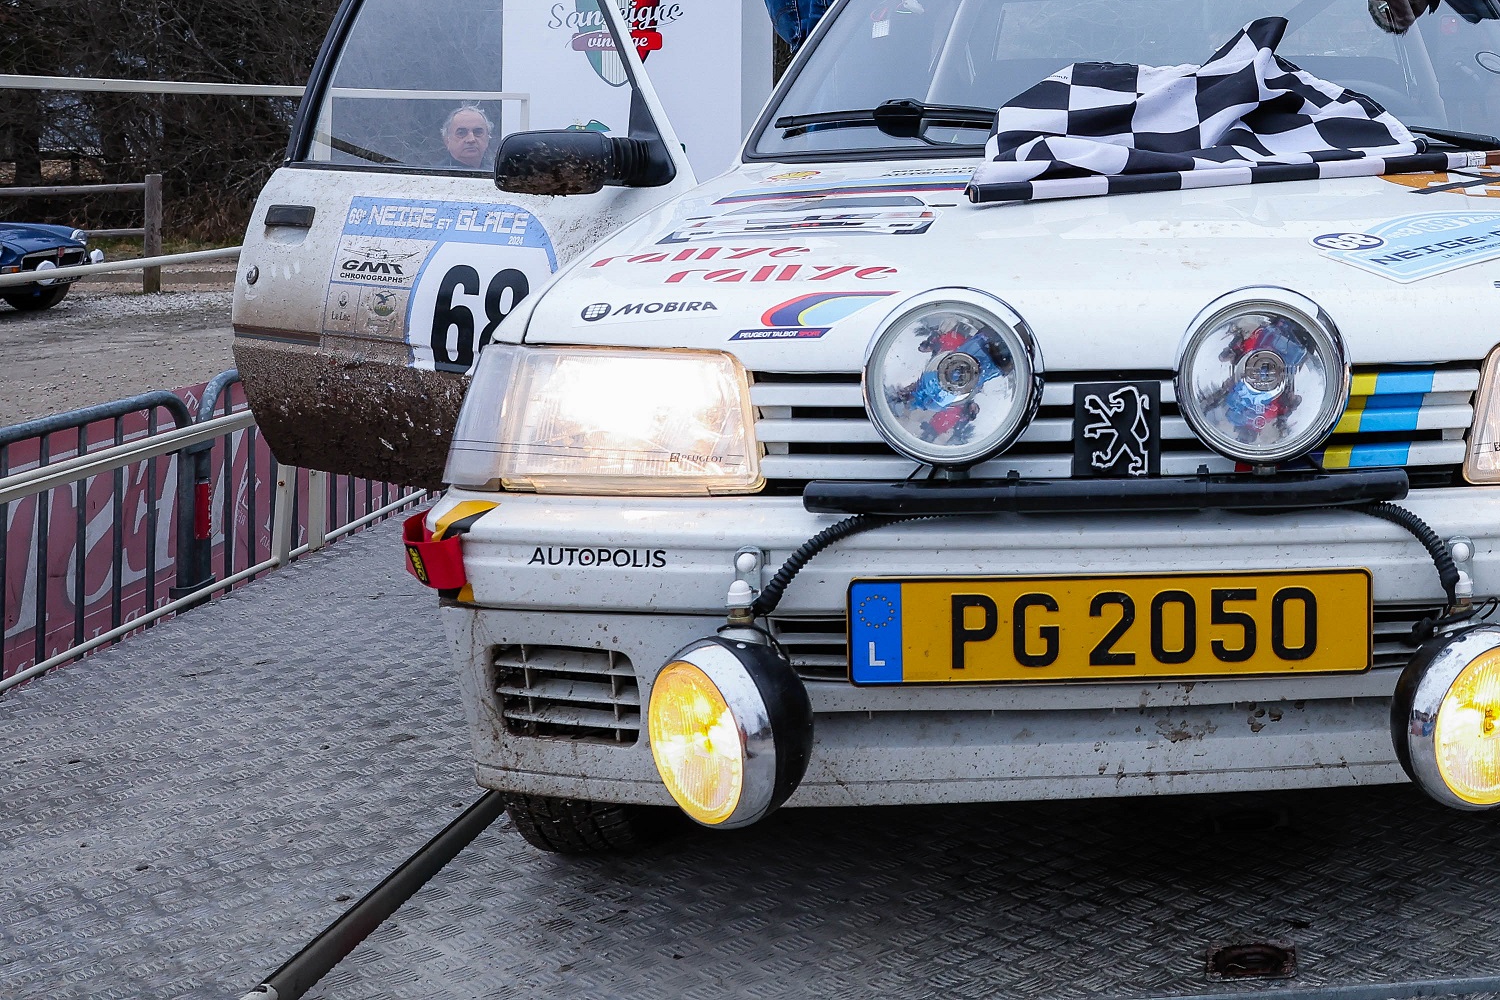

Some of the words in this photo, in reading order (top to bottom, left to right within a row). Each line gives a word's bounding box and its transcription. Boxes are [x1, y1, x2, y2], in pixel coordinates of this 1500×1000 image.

[368, 206, 436, 228] NEIGE
[436, 218, 452, 230] ET
[455, 210, 529, 234] GLACE
[508, 236, 524, 245] 2024
[1318, 234, 1380, 250] 68
[590, 246, 810, 268] rallye
[1369, 236, 1486, 266] NEIGE
[342, 260, 404, 274] GMT
[664, 264, 898, 283] rallye
[340, 272, 402, 283] CHRONOGRAPHS
[612, 301, 718, 316] MOBIRA
[681, 454, 723, 462] PEUGEOT
[527, 547, 666, 569] AUTOPOLIS
[950, 592, 1060, 670] PG
[1088, 586, 1318, 666] 2050
[868, 642, 886, 666] L
